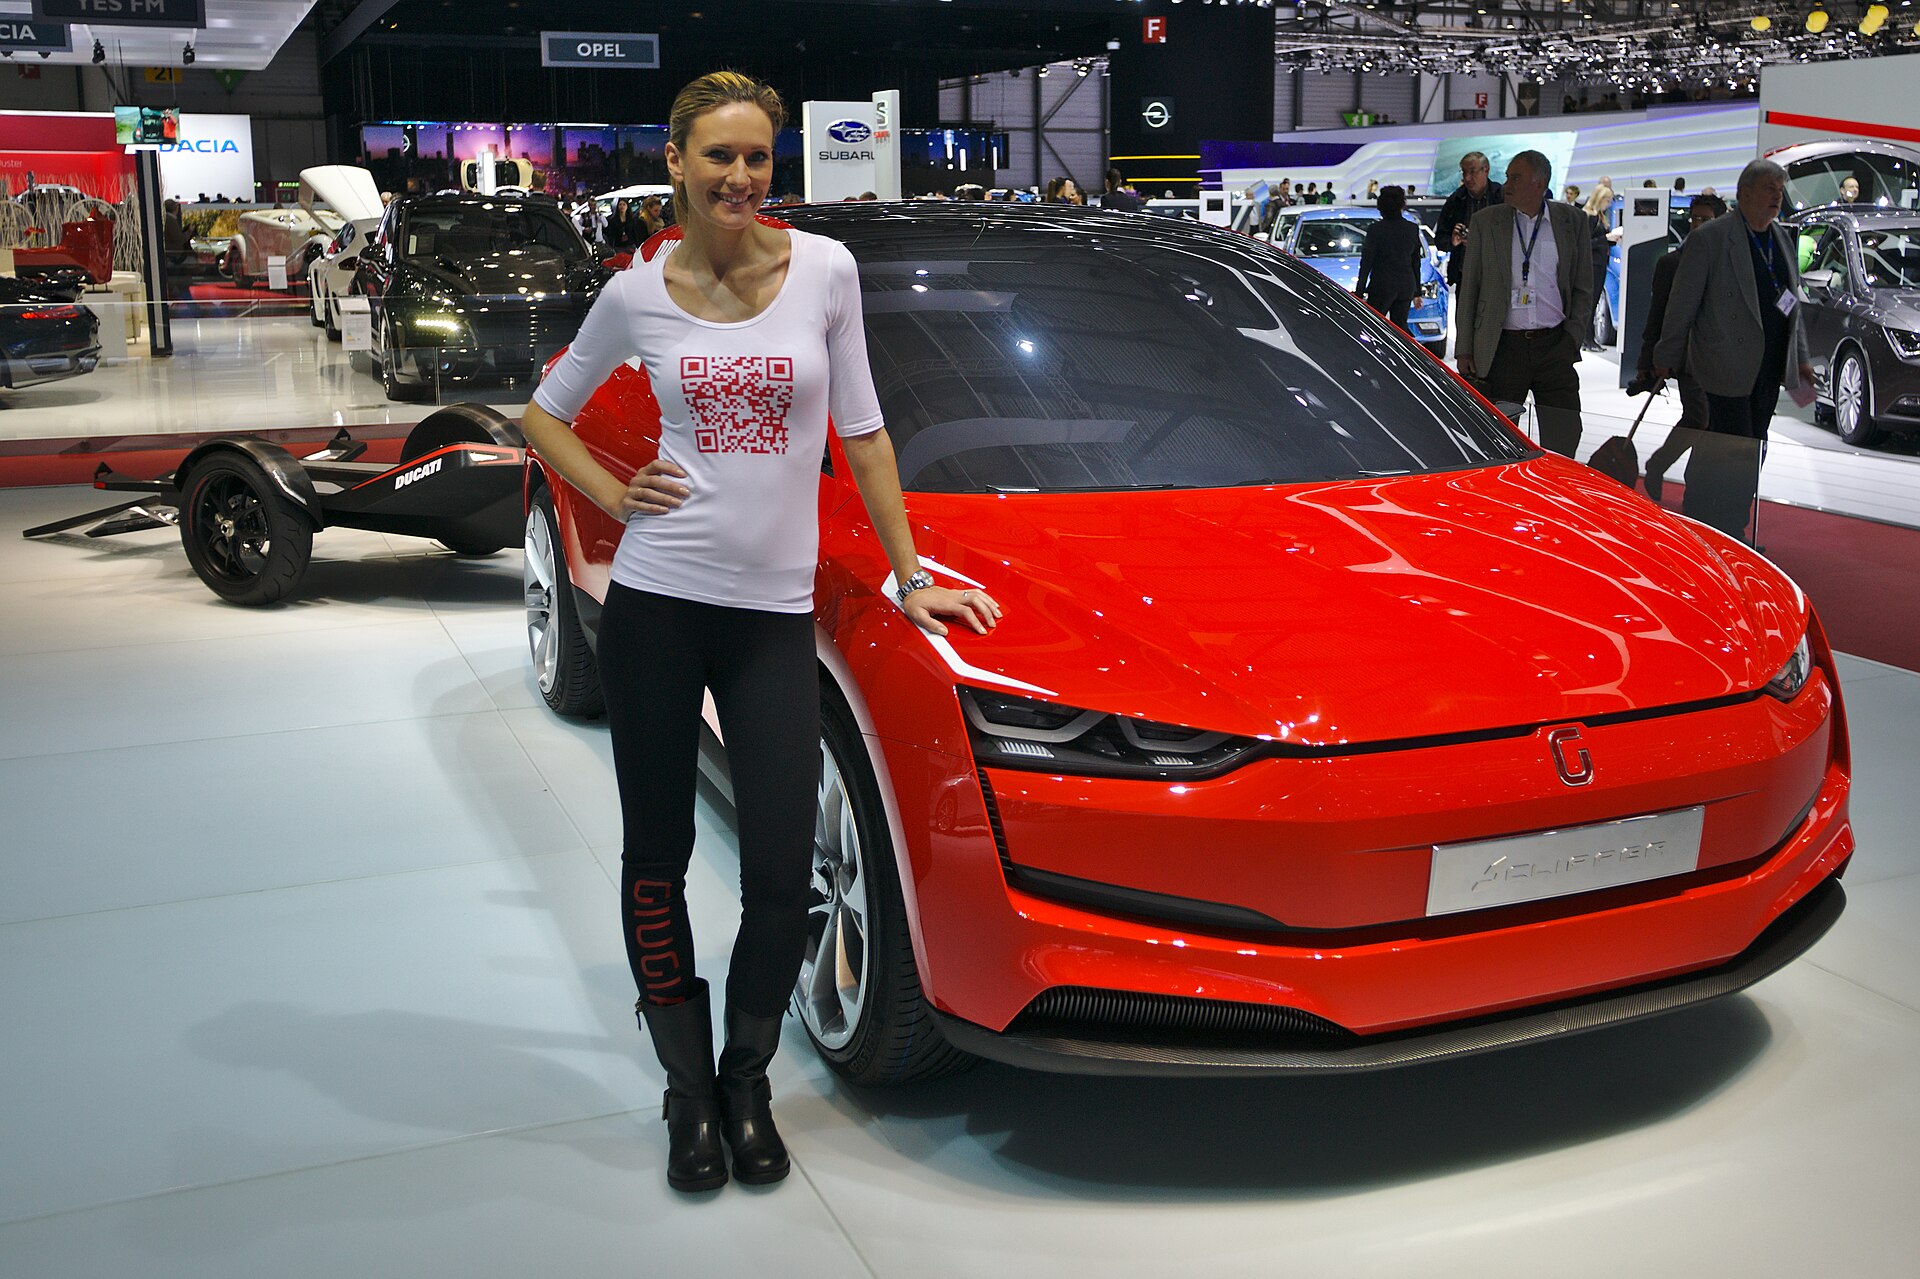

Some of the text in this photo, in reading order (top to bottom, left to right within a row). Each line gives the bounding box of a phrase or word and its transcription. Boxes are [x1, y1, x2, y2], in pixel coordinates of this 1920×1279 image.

[131, 0, 165, 13] FM
[1148, 19, 1160, 38] F
[576, 43, 626, 57] OPEL
[153, 67, 173, 81] 21
[159, 140, 240, 153] DACIA
[395, 457, 443, 490] DUCATI
[1505, 841, 1667, 881] CLIPPER
